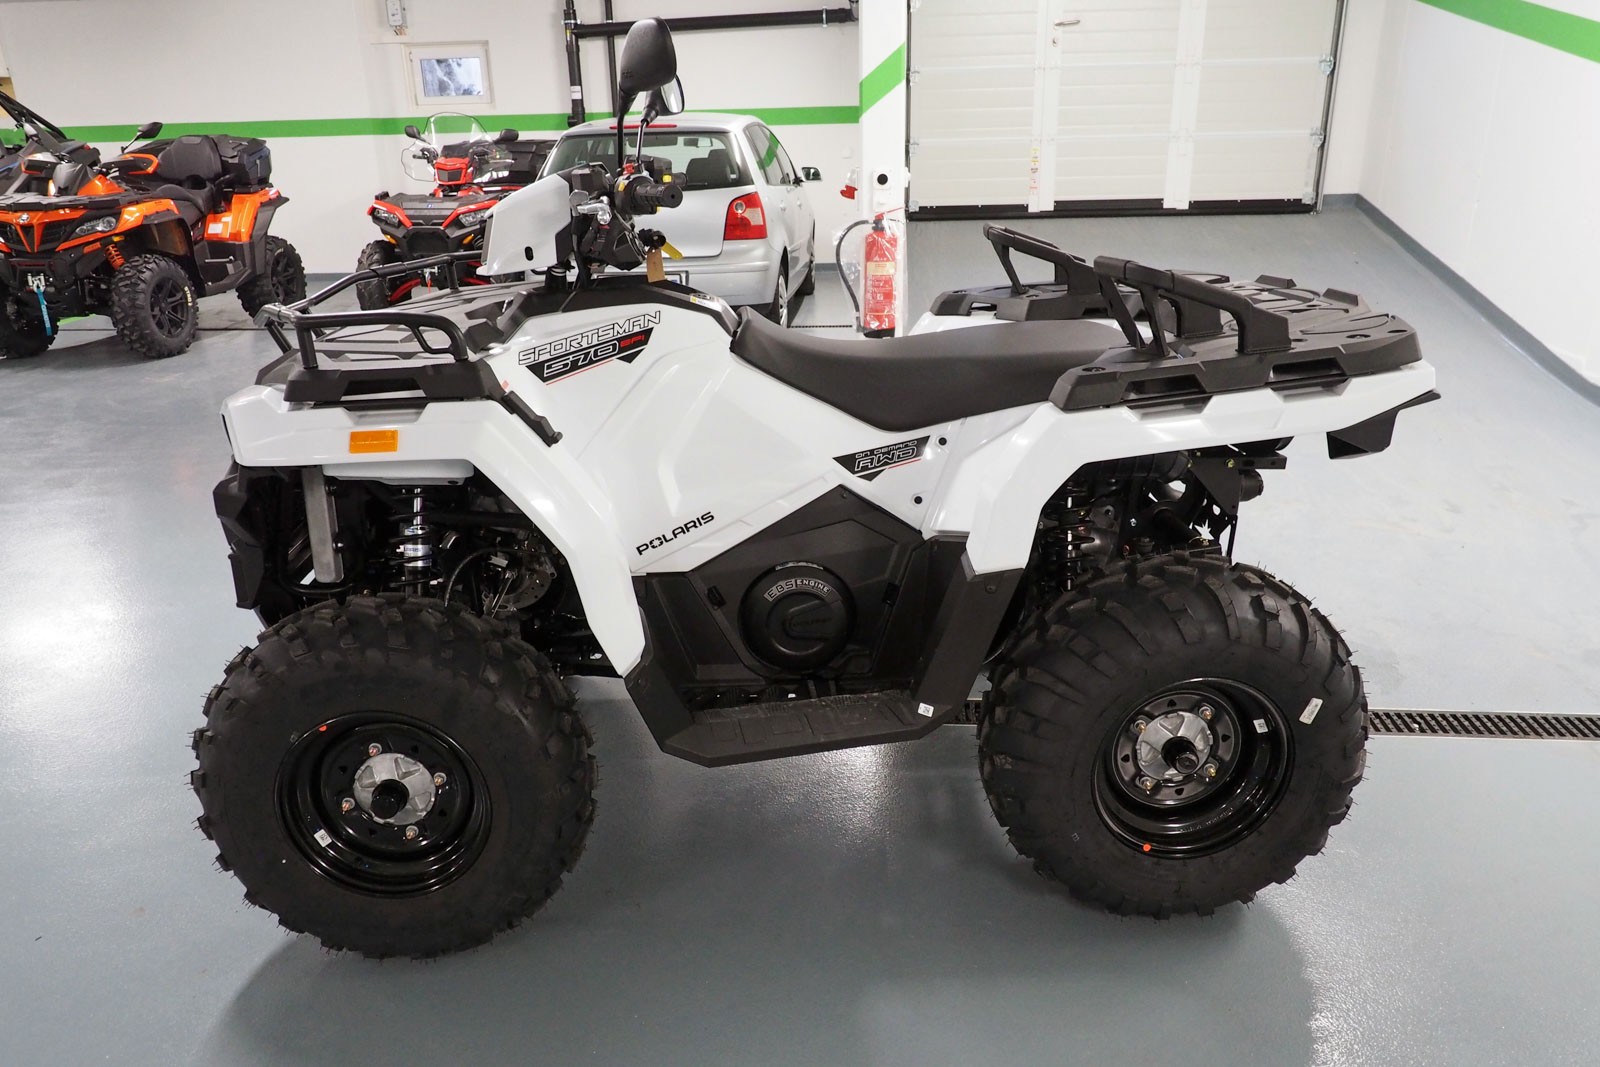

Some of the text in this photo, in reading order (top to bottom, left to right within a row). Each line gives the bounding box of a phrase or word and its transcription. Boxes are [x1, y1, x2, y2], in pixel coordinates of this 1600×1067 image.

[518, 310, 661, 366] SPORTSMAN
[544, 341, 620, 378] 570
[854, 446, 917, 471] AWD
[855, 440, 918, 459] ON DEMAND
[636, 511, 715, 556] POLARIS
[767, 579, 831, 599] EBS ENGINE
